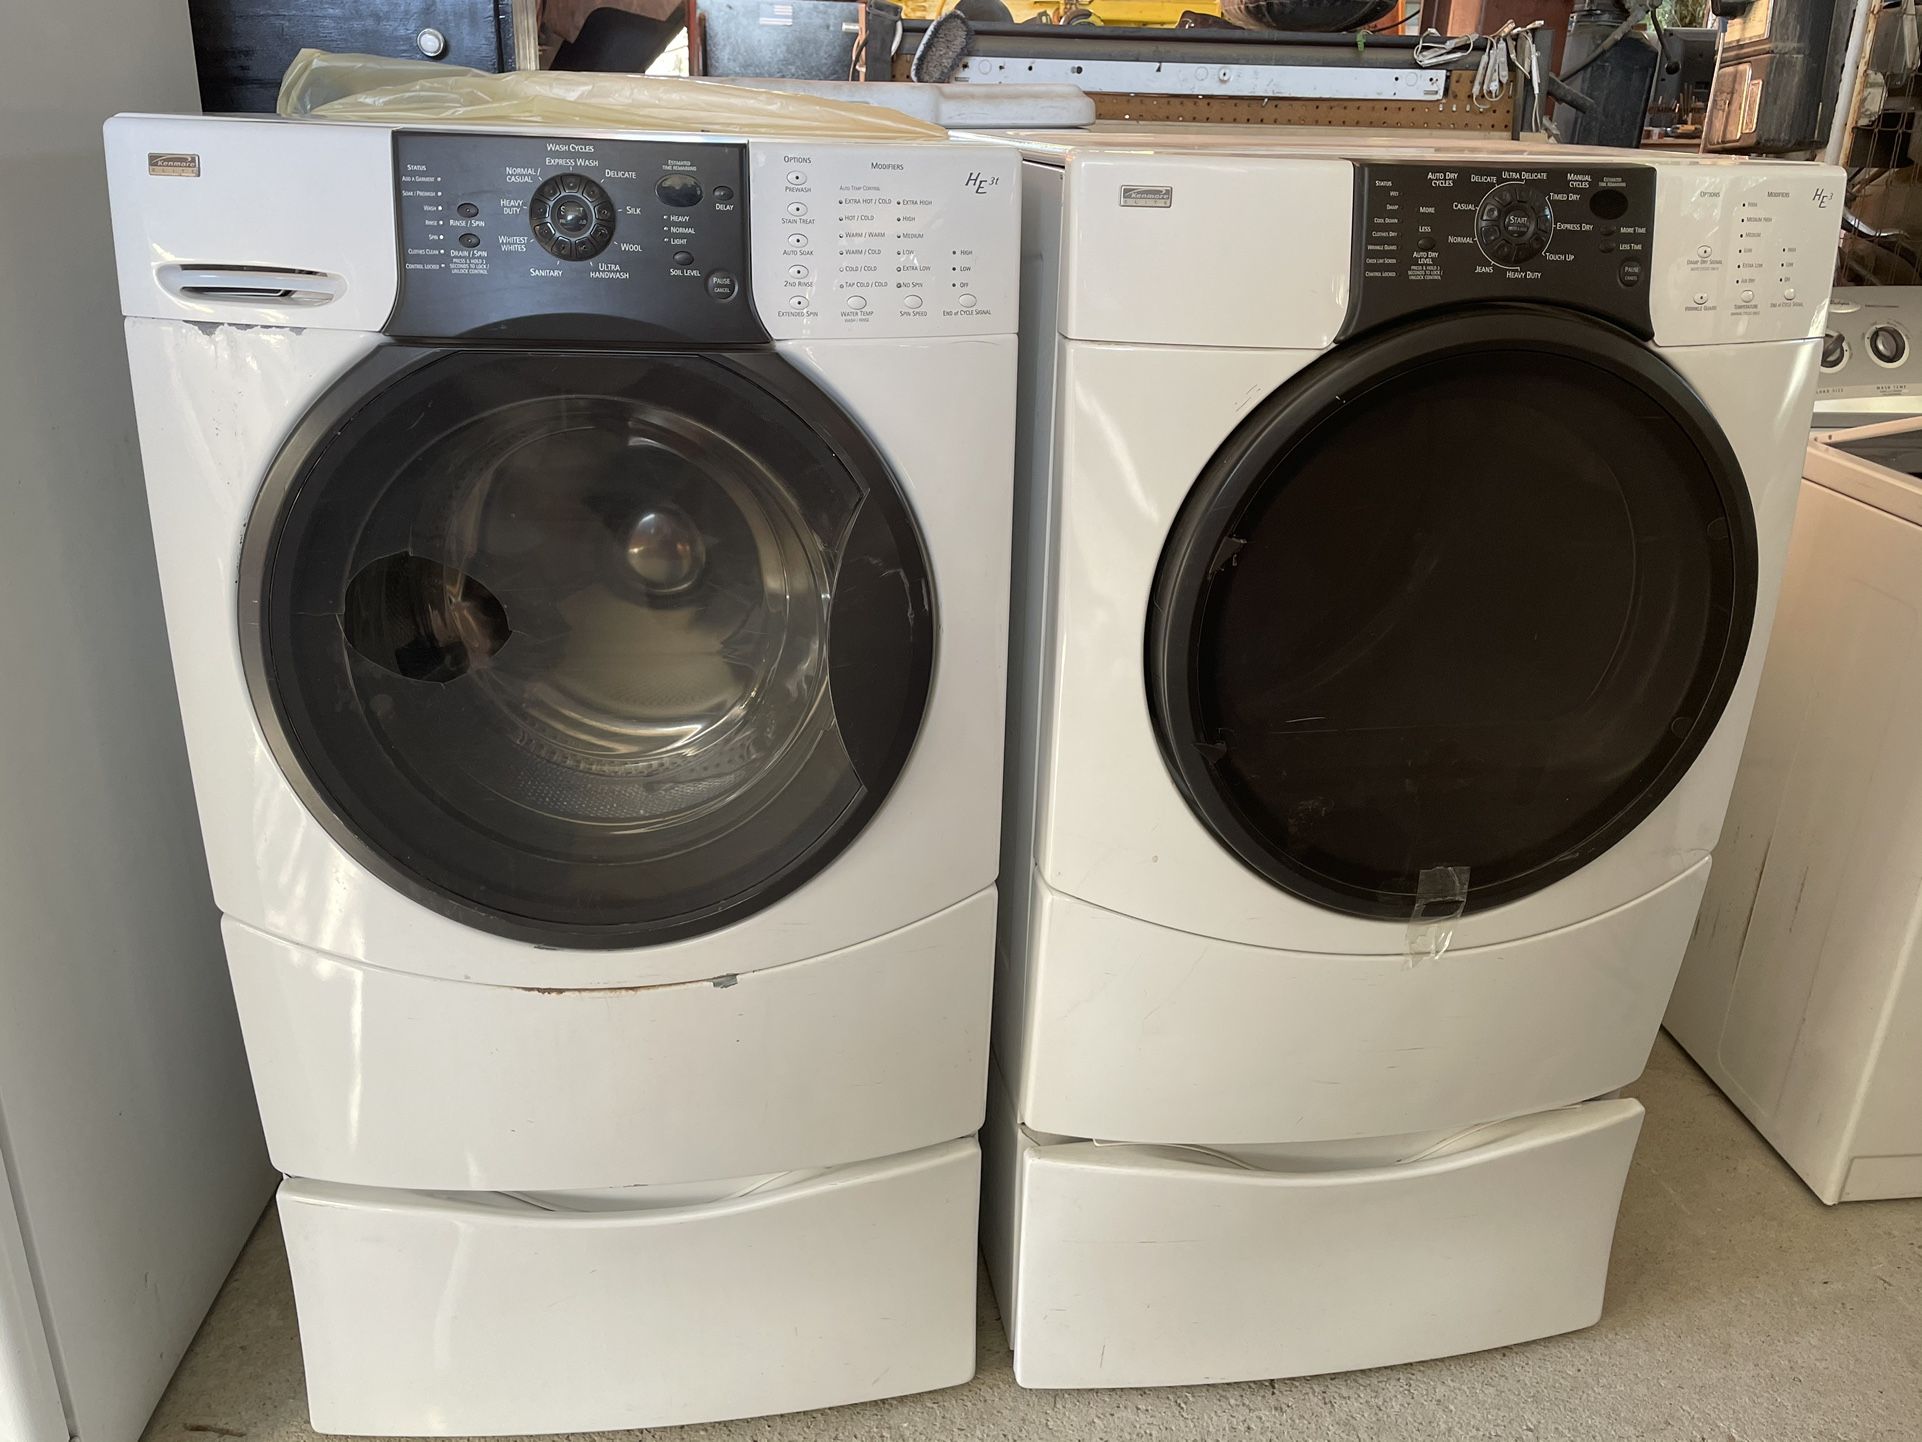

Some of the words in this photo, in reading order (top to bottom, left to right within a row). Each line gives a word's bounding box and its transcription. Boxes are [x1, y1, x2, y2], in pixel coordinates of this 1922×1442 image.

[547, 144, 568, 152] WASH
[570, 144, 594, 152] CYCLES
[546, 158, 575, 166] EXPRESS
[576, 158, 599, 166] WASH
[784, 156, 812, 164] OPTIONS
[871, 162, 904, 170] MODIFIERS
[506, 167, 536, 175] NORMAL
[606, 170, 636, 179] DELICATE
[1428, 172, 1444, 180] AUTO
[1446, 172, 1458, 180] DRY
[1471, 175, 1497, 183] DELICATE
[1502, 171, 1520, 179] ULTRA
[1522, 172, 1548, 180] DELICATE
[1568, 173, 1592, 181] MANUAL
[1550, 193, 1568, 201] TIMED
[1569, 193, 1580, 201] DRY
[501, 199, 523, 207] HEAVY
[1453, 202, 1475, 210] CASUAL
[627, 206, 641, 215] SILK
[1510, 216, 1528, 224] START
[1557, 223, 1580, 231] EXPRESS
[1582, 223, 1594, 231] DRY
[499, 236, 528, 244] WHITEST
[1448, 236, 1474, 244] NORMAL
[621, 243, 642, 252] WOOL
[1546, 253, 1564, 261] TOUCH
[1566, 253, 1574, 261] UP
[599, 263, 621, 271] ULTRA
[530, 268, 563, 277] SANITARY
[1507, 271, 1526, 279] HEAVY
[1527, 271, 1542, 279] DUTY
